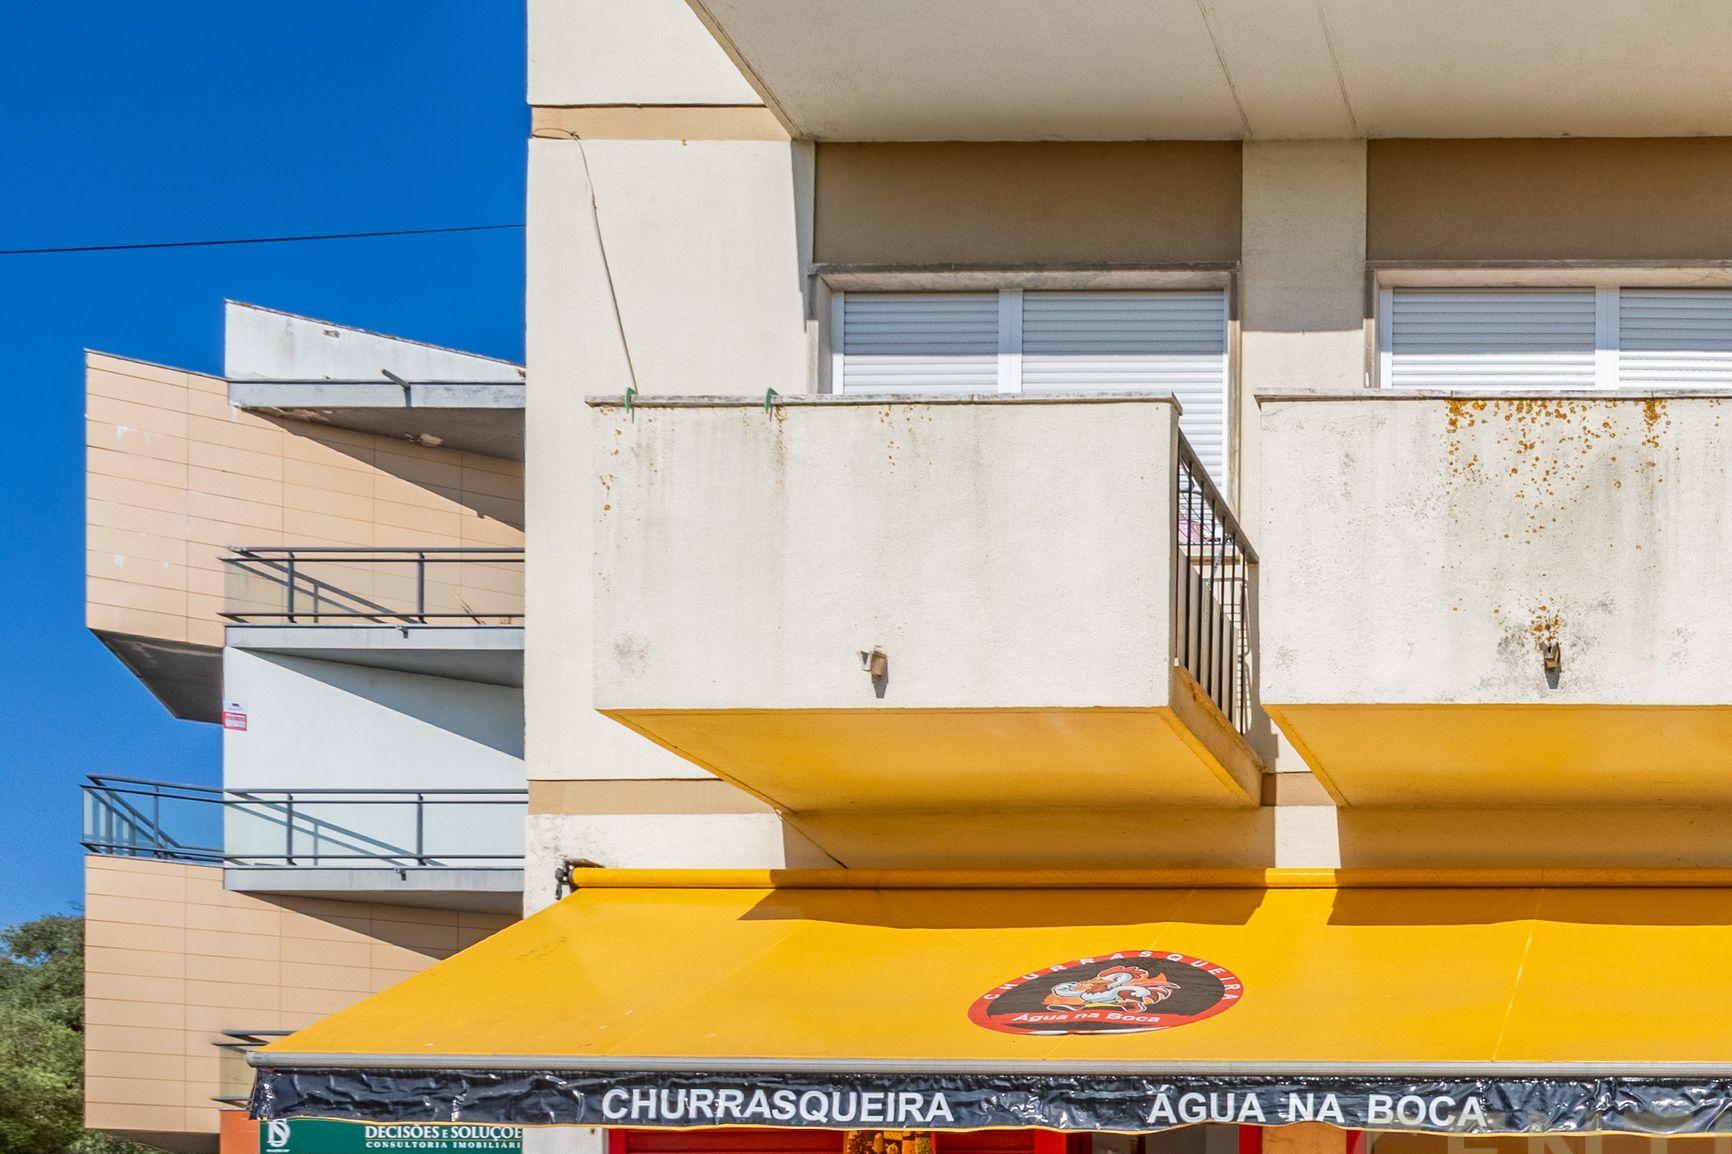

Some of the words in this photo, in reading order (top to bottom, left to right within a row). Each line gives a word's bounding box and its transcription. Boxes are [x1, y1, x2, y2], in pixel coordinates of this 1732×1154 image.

[983, 951, 1240, 1000] CHURRASQUEIRA
[1013, 1010, 1068, 1023] Água
[1106, 1011, 1160, 1023] Boca
[601, 1088, 954, 1123] CHURRASQUEIRA
[1147, 1086, 1265, 1124] ÁGUA
[1288, 1092, 1345, 1124] NA
[1367, 1094, 1490, 1127] BOCA
[365, 1125, 439, 1139] DECISÕES
[442, 1129, 449, 1138] E
